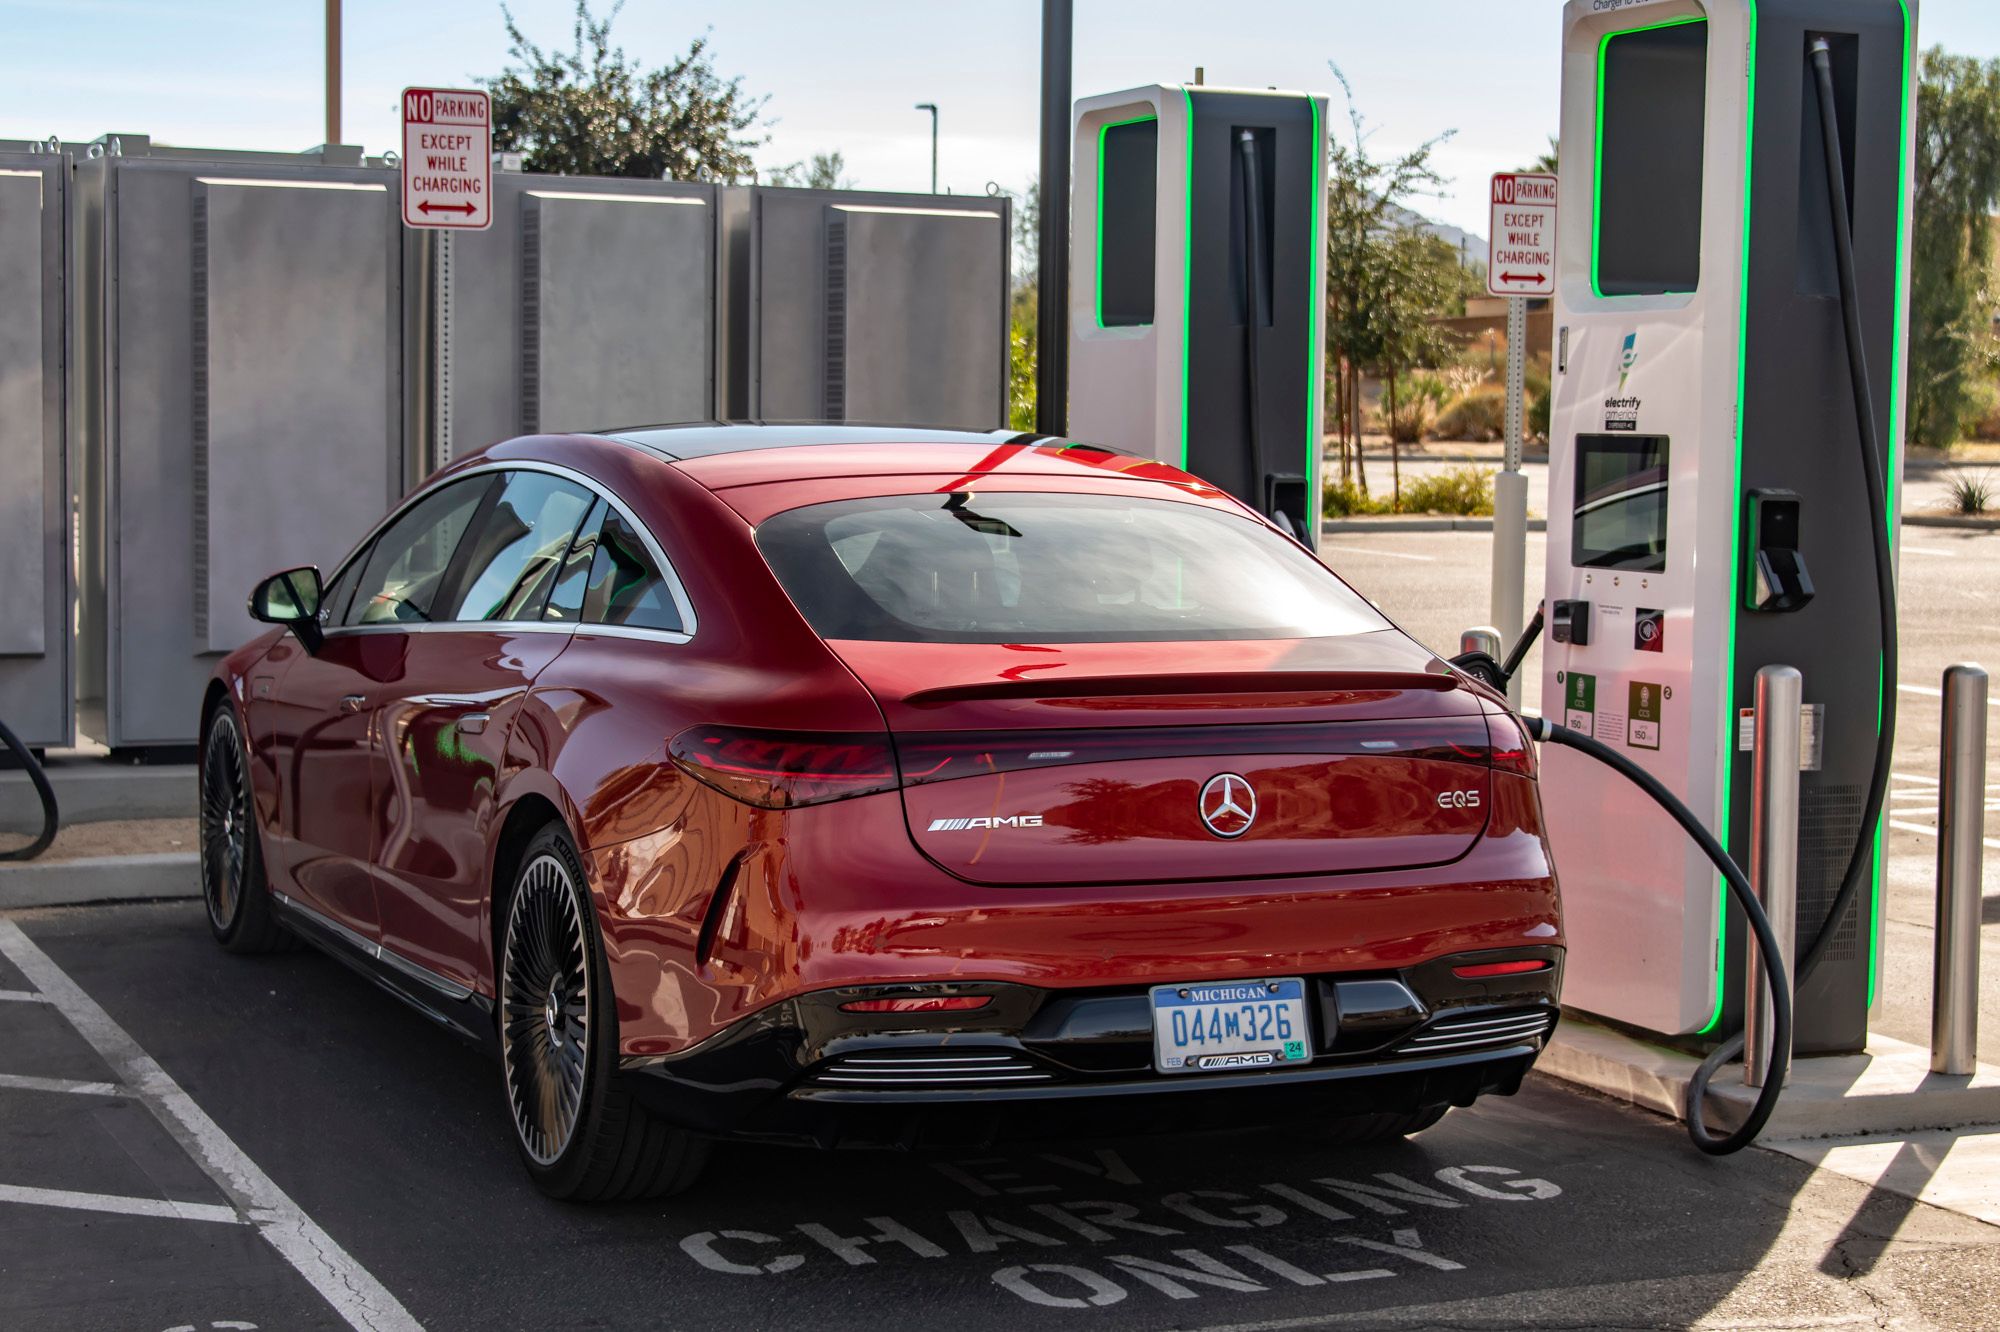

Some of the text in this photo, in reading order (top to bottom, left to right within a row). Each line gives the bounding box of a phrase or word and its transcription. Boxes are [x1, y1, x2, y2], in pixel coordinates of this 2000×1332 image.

[407, 94, 484, 122] NO PARKING
[421, 134, 472, 150] EXCEPT
[427, 155, 467, 171] WHILE
[413, 176, 481, 193] CHARGING
[1494, 178, 1554, 203] NO PARKING
[1504, 213, 1544, 227] EXCEPT
[1508, 232, 1539, 246] WHILE
[1496, 250, 1549, 265] CHARGING
[1605, 397, 1641, 410] electrify
[1437, 790, 1480, 809] EQS
[966, 815, 1043, 830] AMG
[1191, 986, 1267, 1002] MICHIGAN
[1172, 1003, 1292, 1047] 044M326
[1288, 1042, 1302, 1053] 24
[1166, 1057, 1182, 1067] FEB
[1225, 1054, 1270, 1066] AMG
[679, 1165, 1562, 1275] CHARGING
[991, 1227, 1467, 1308] ONLY
